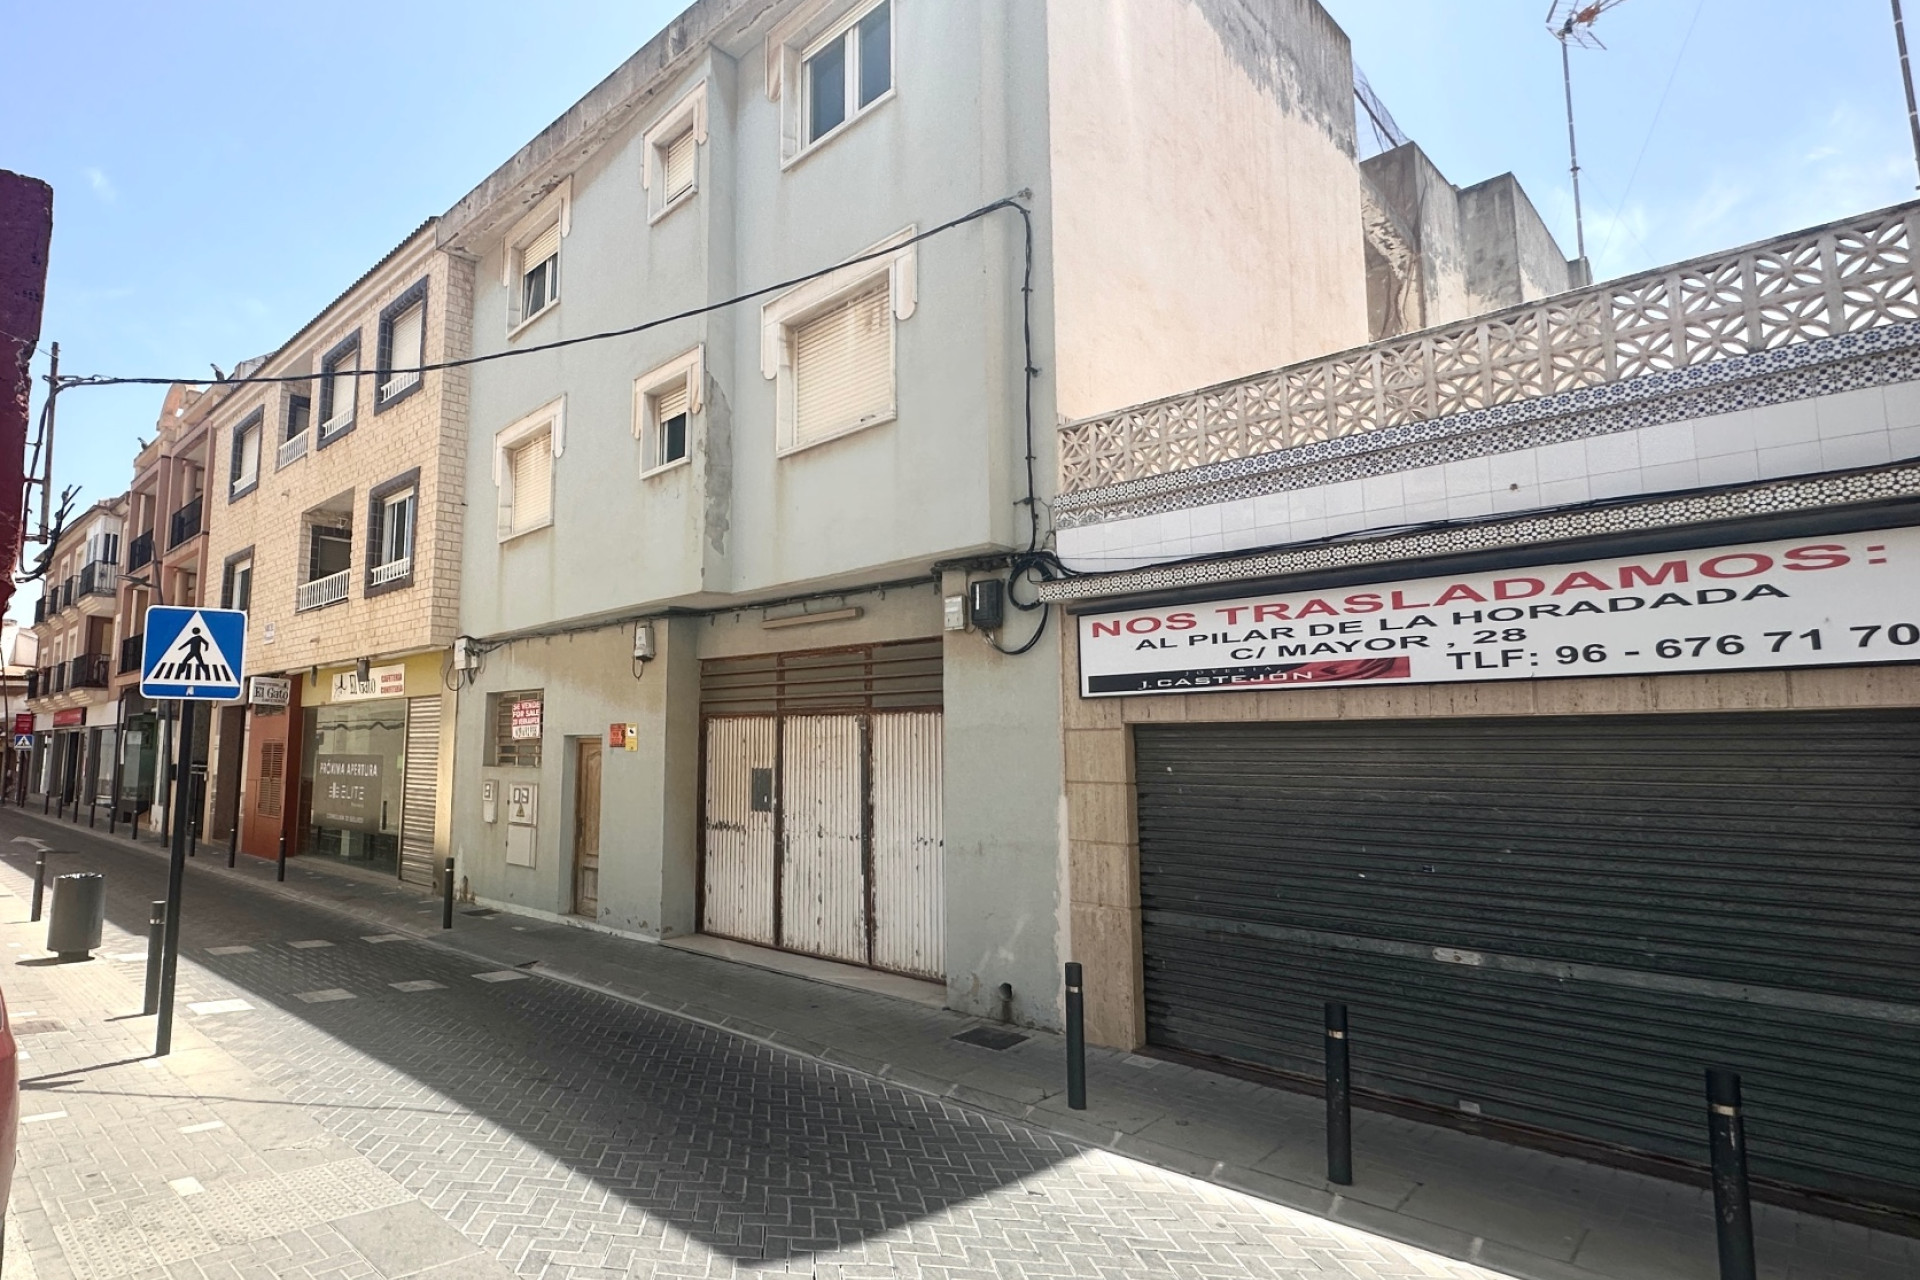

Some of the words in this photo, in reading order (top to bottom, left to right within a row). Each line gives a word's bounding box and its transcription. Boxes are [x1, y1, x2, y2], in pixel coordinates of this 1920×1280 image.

[1092, 612, 1197, 638] NOS
[1215, 544, 1887, 625] TRASLADAMOS:
[1135, 638, 1178, 651] AL
[1188, 627, 1295, 646] PILAR
[1308, 620, 1364, 637] DE
[1379, 614, 1438, 631] LA
[1452, 583, 1790, 625] HORADADA
[1230, 646, 1266, 660] C/
[1277, 635, 1430, 657] MAYOR
[1472, 628, 1527, 644] 28
[1446, 648, 1538, 670] TLF:
[1556, 643, 1607, 665] 96
[1655, 634, 1745, 659] 676
[1763, 628, 1823, 653] 71
[1849, 622, 1920, 648] 70
[255, 686, 264, 698] El
[266, 687, 289, 700] Gato
[513, 710, 525, 718] FOR
[525, 709, 540, 717] SALE
[346, 763, 378, 776] APERTURA
[341, 784, 365, 800] ELITE
